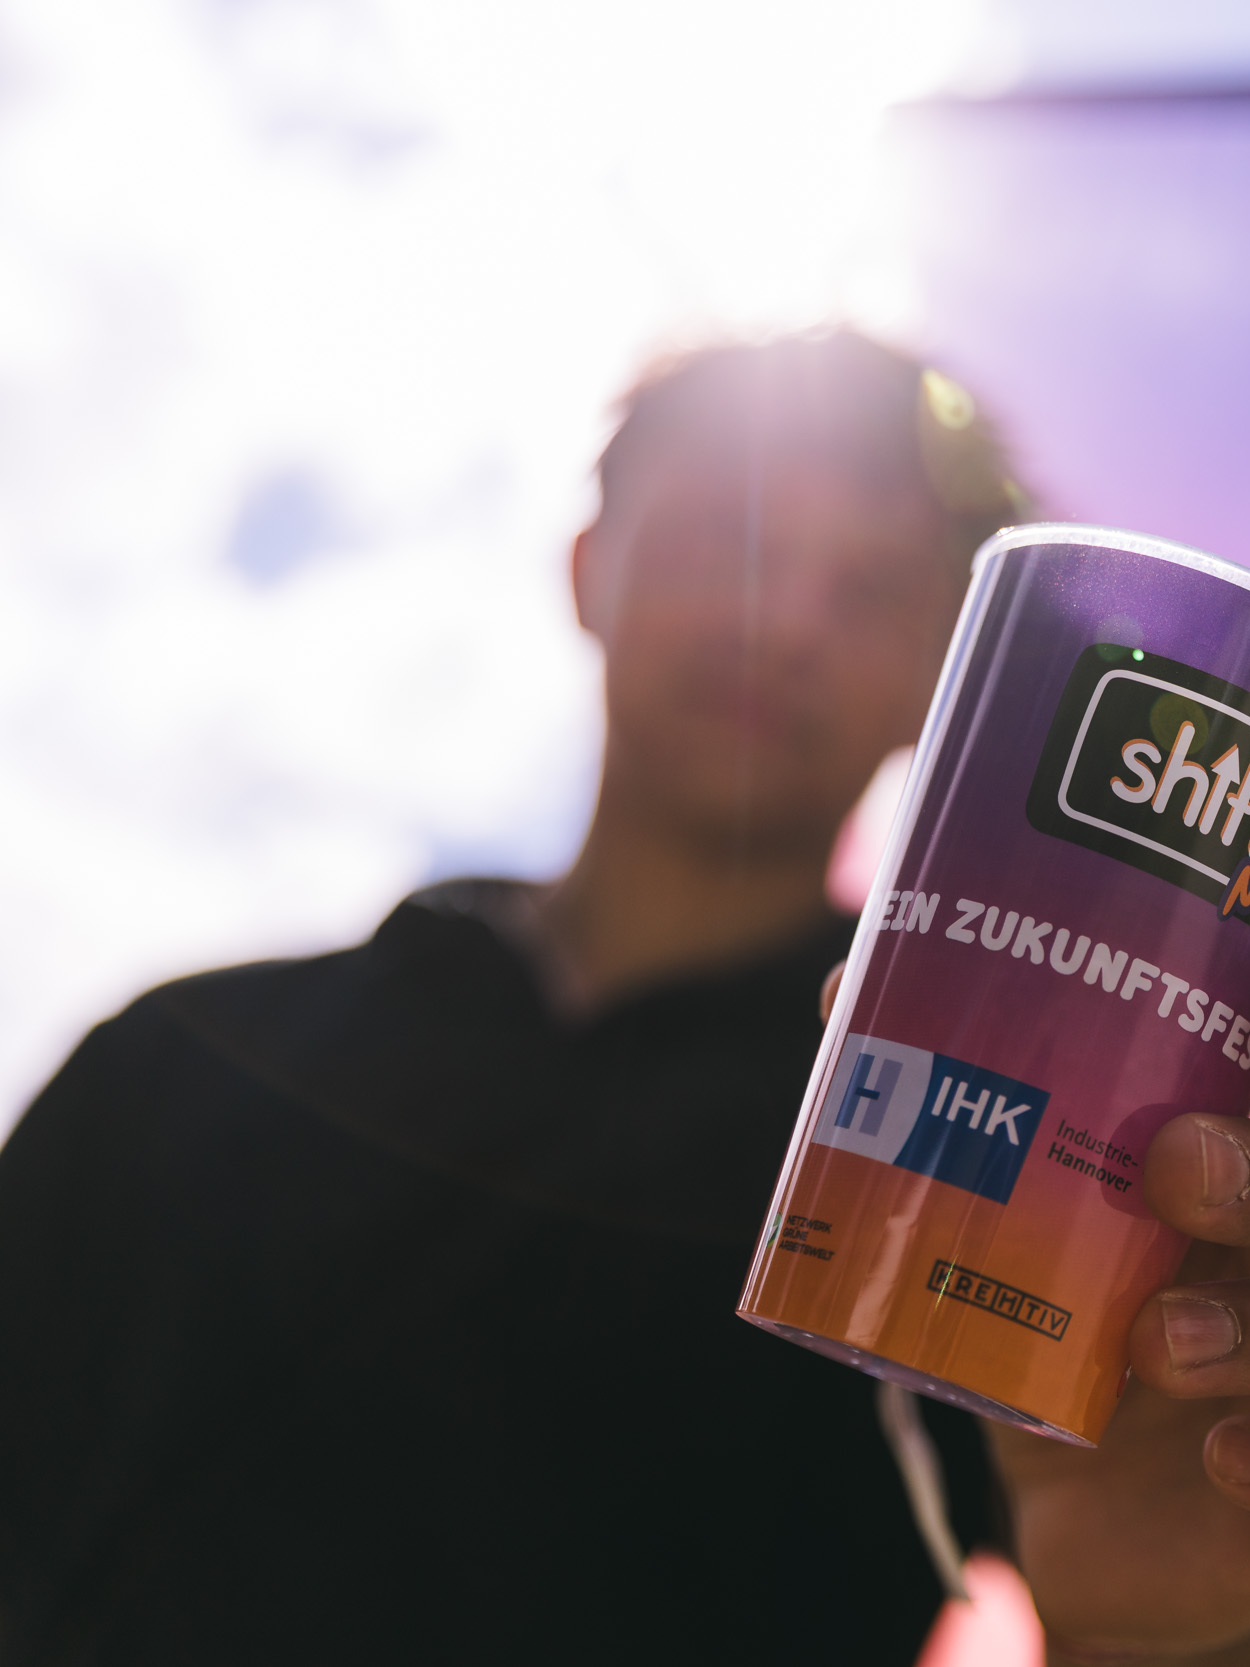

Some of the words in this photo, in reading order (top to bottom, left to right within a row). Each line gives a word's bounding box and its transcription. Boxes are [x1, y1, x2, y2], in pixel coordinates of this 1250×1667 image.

[835, 1052, 903, 1137] H
[931, 1076, 1032, 1146] IHK
[1047, 1142, 1132, 1193] Hannover
[1057, 1120, 1139, 1169] Industrie-
[787, 1215, 833, 1234] NETZWERK
